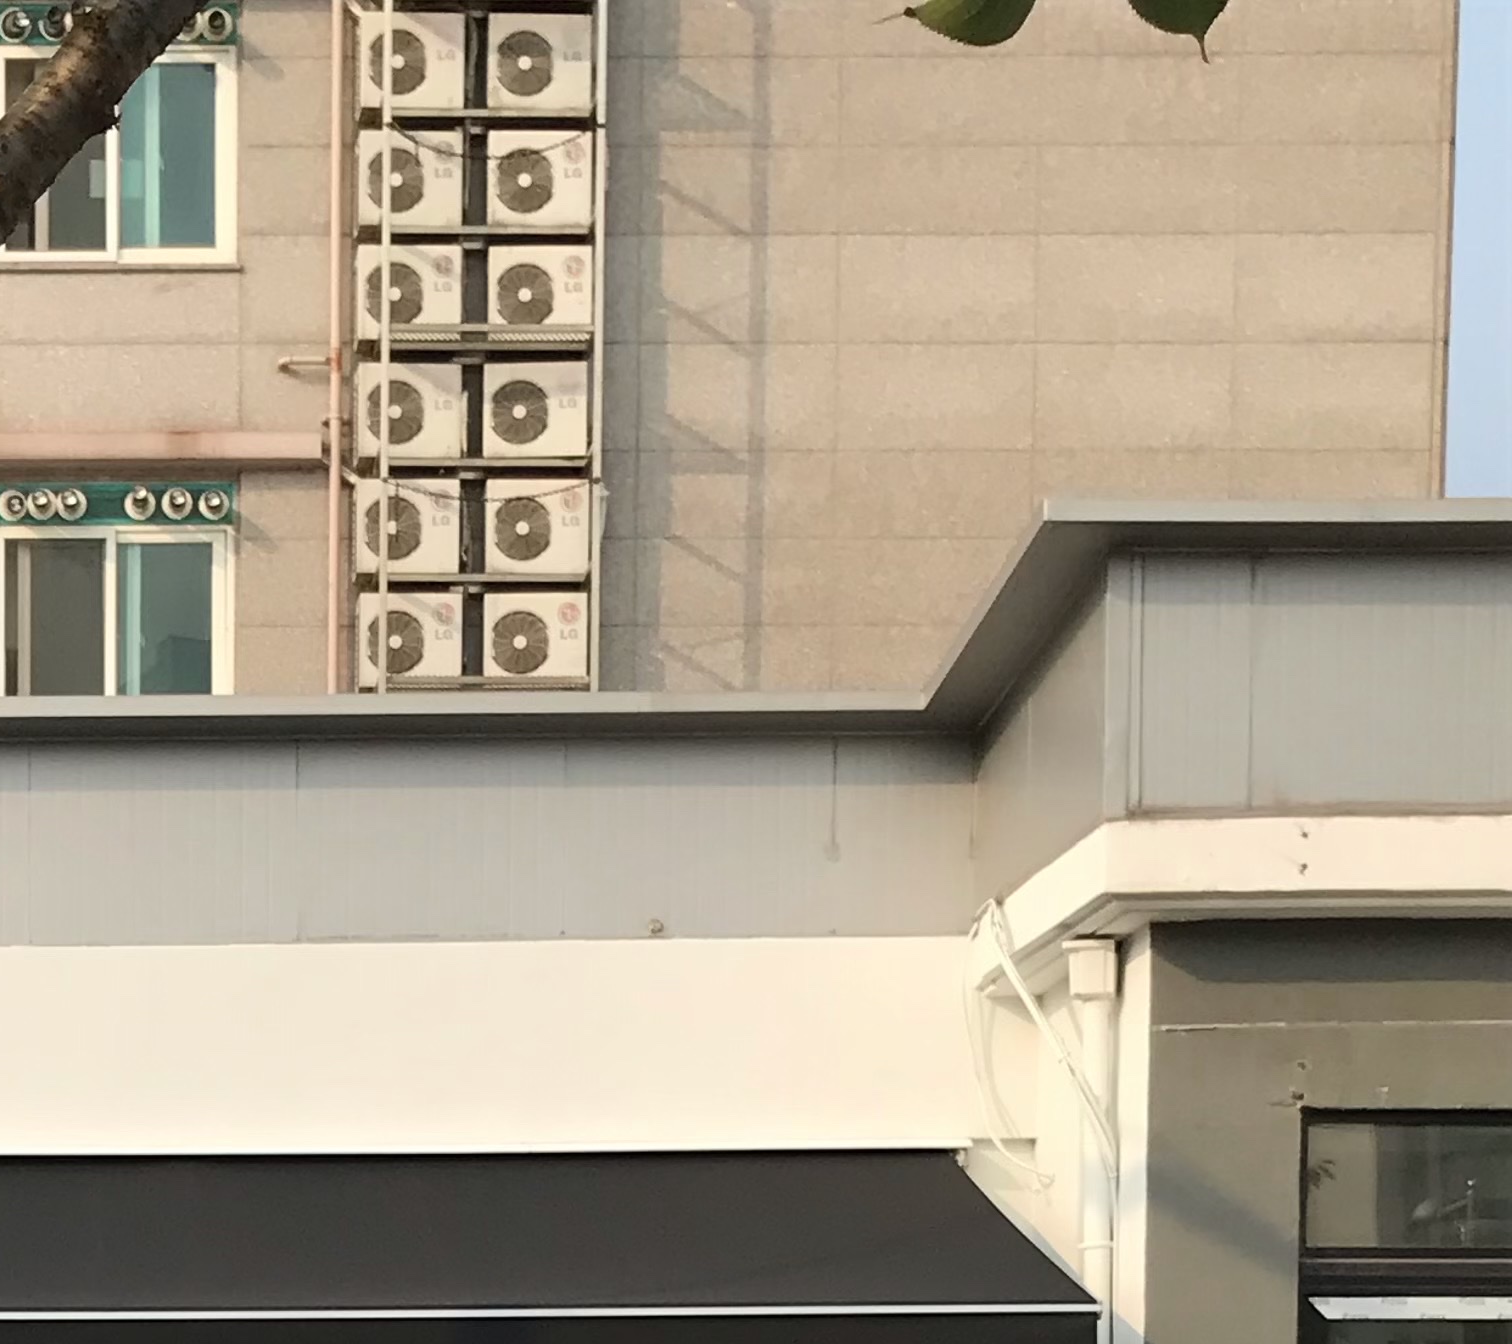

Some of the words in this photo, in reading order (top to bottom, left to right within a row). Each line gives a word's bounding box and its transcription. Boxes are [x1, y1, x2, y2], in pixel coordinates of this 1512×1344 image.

[434, 167, 453, 179] LG
[564, 167, 583, 179] LG
[434, 281, 453, 293] LG
[564, 281, 583, 293] LG
[434, 399, 453, 411] LG
[558, 397, 577, 409] LG
[432, 515, 451, 527] LG
[561, 515, 580, 527] LG
[434, 629, 454, 641] LG
[559, 628, 579, 641] LG
